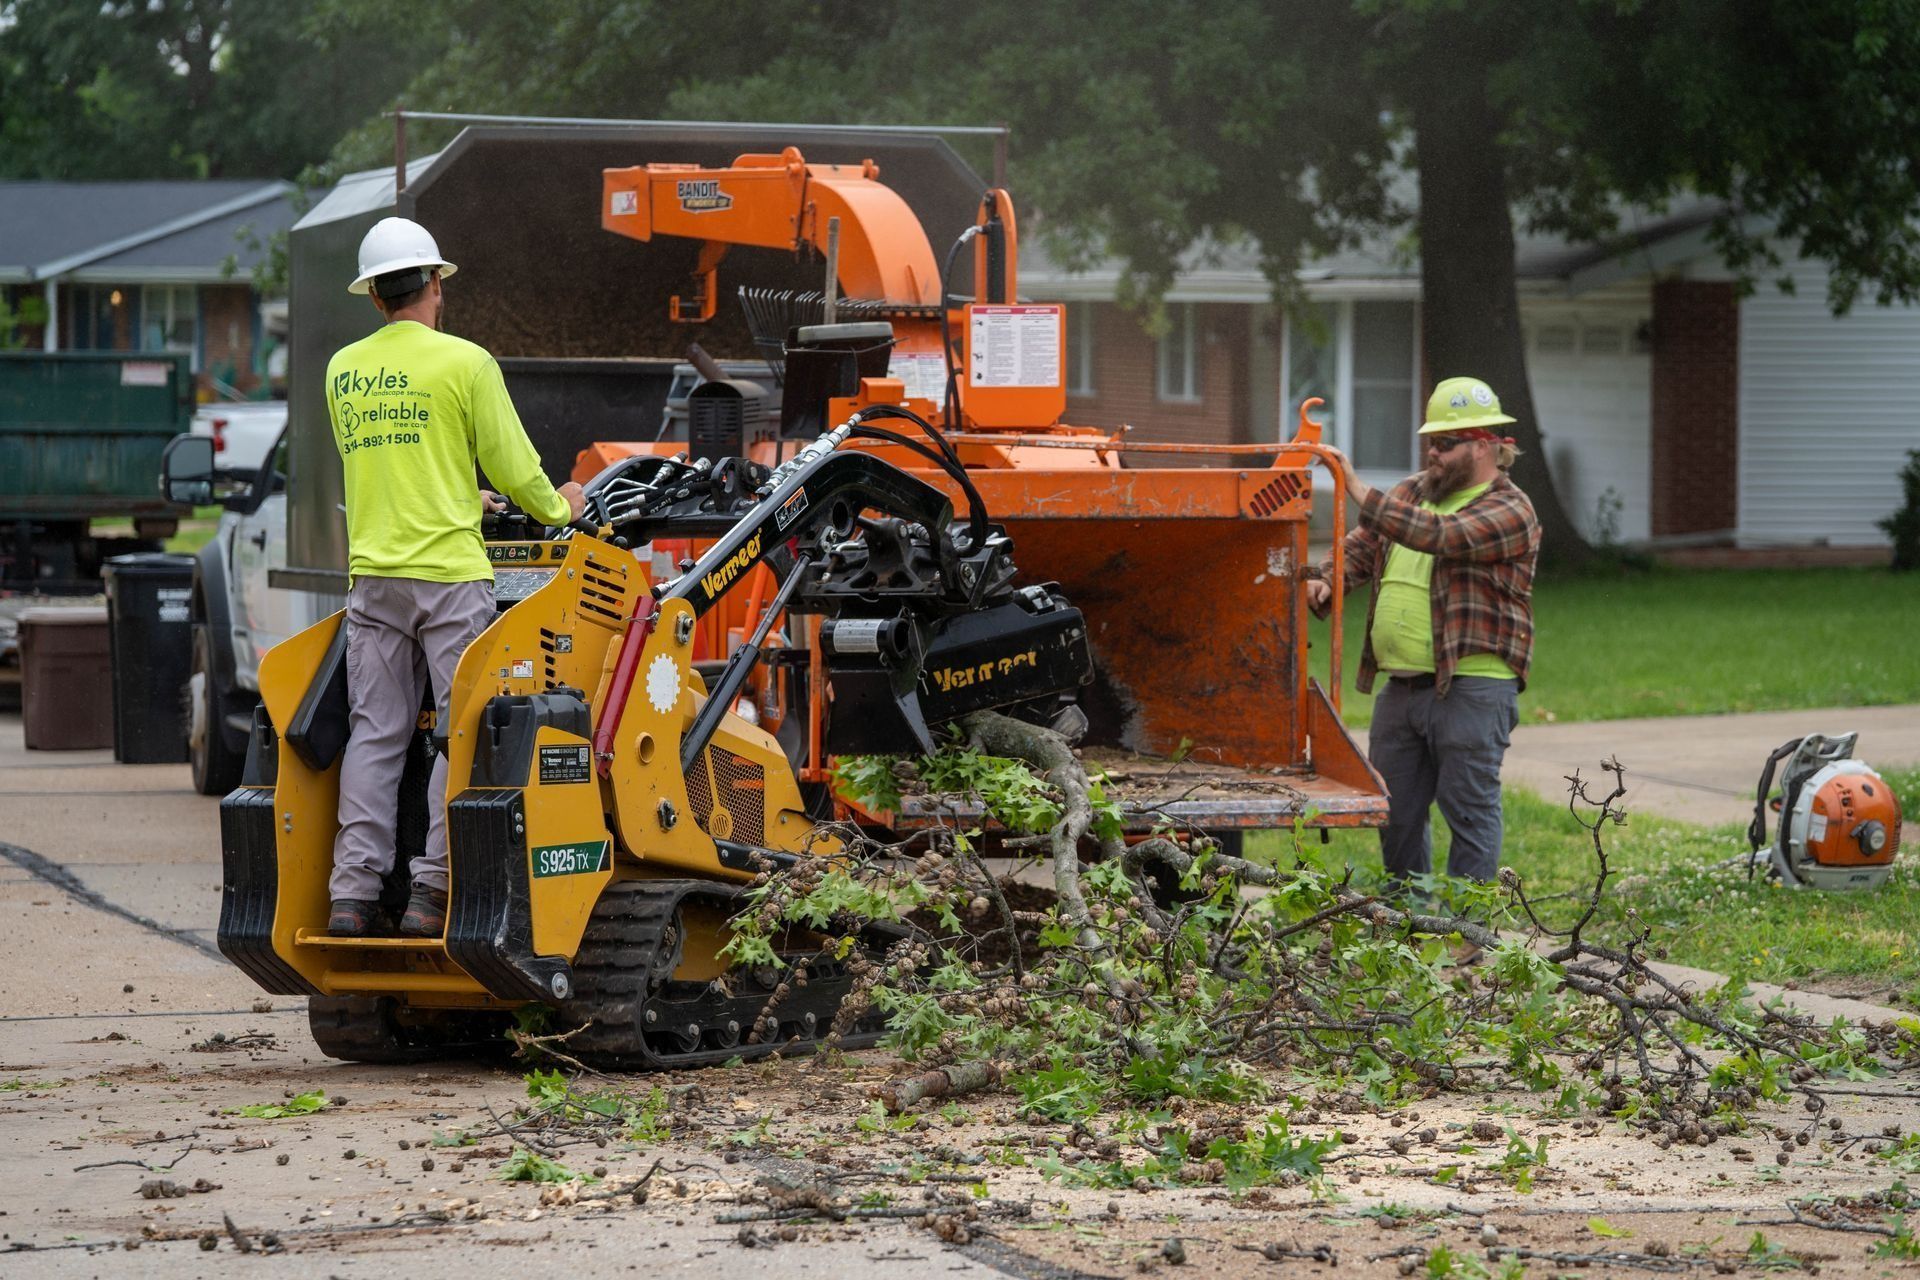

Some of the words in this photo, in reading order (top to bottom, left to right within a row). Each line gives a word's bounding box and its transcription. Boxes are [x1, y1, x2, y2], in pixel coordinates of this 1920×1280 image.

[677, 181, 719, 198] BANDIT
[352, 367, 408, 397] kyle's
[362, 401, 429, 422] reliable
[343, 433, 420, 454] 314-892-1500
[700, 533, 762, 600] Vermeer
